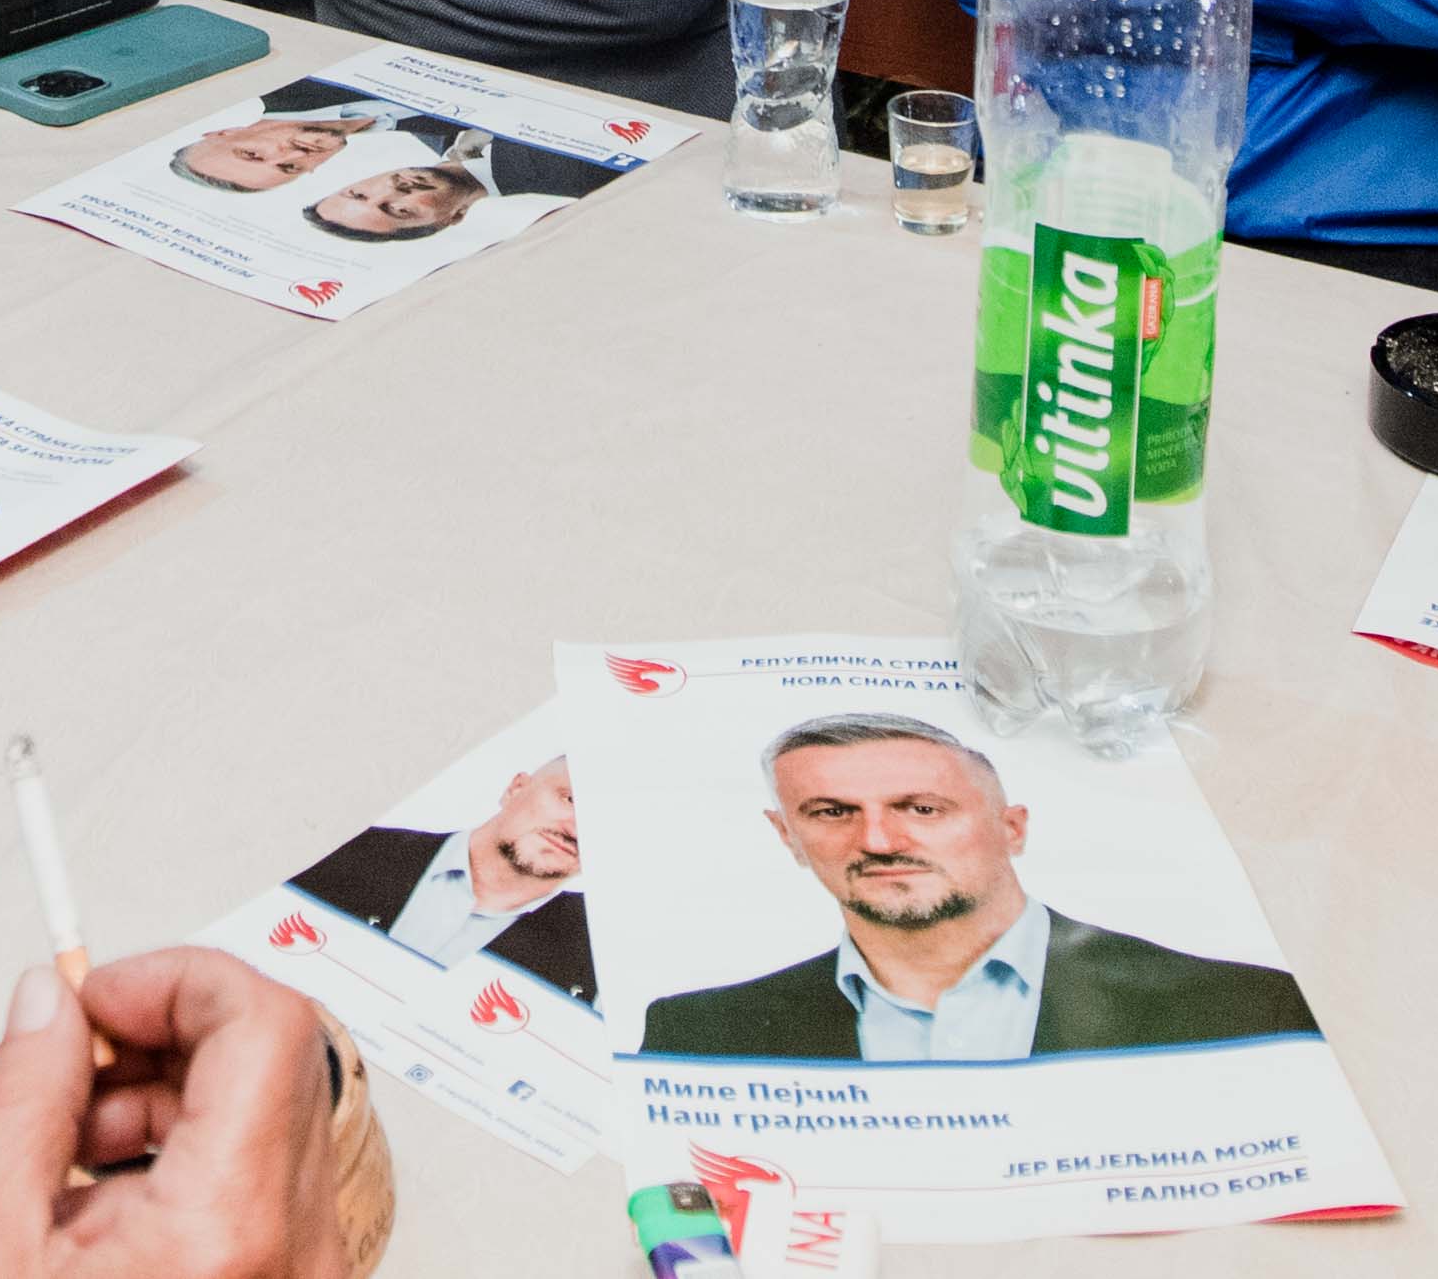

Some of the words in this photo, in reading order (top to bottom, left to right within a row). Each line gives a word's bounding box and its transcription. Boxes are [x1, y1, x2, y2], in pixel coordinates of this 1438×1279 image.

[1035, 250, 1119, 518] vitinka
[741, 654, 883, 668] РЕПУБЛИЧКА
[782, 675, 842, 687] НОВА
[848, 675, 917, 690] СНАГА
[924, 681, 948, 691] ЗА
[643, 1077, 737, 1101] Миле
[747, 1082, 870, 1107] Пејчић
[647, 1104, 721, 1126] Наш
[733, 1112, 1013, 1133] градоначелник
[1003, 1160, 1050, 1179] ЈЕР
[1056, 1148, 1208, 1173] БИЈЕЉИНА
[1215, 1134, 1302, 1161] МОЖЕ
[1105, 1180, 1220, 1203] РЕАЛНО
[1228, 1167, 1310, 1193] БОЉЕ
